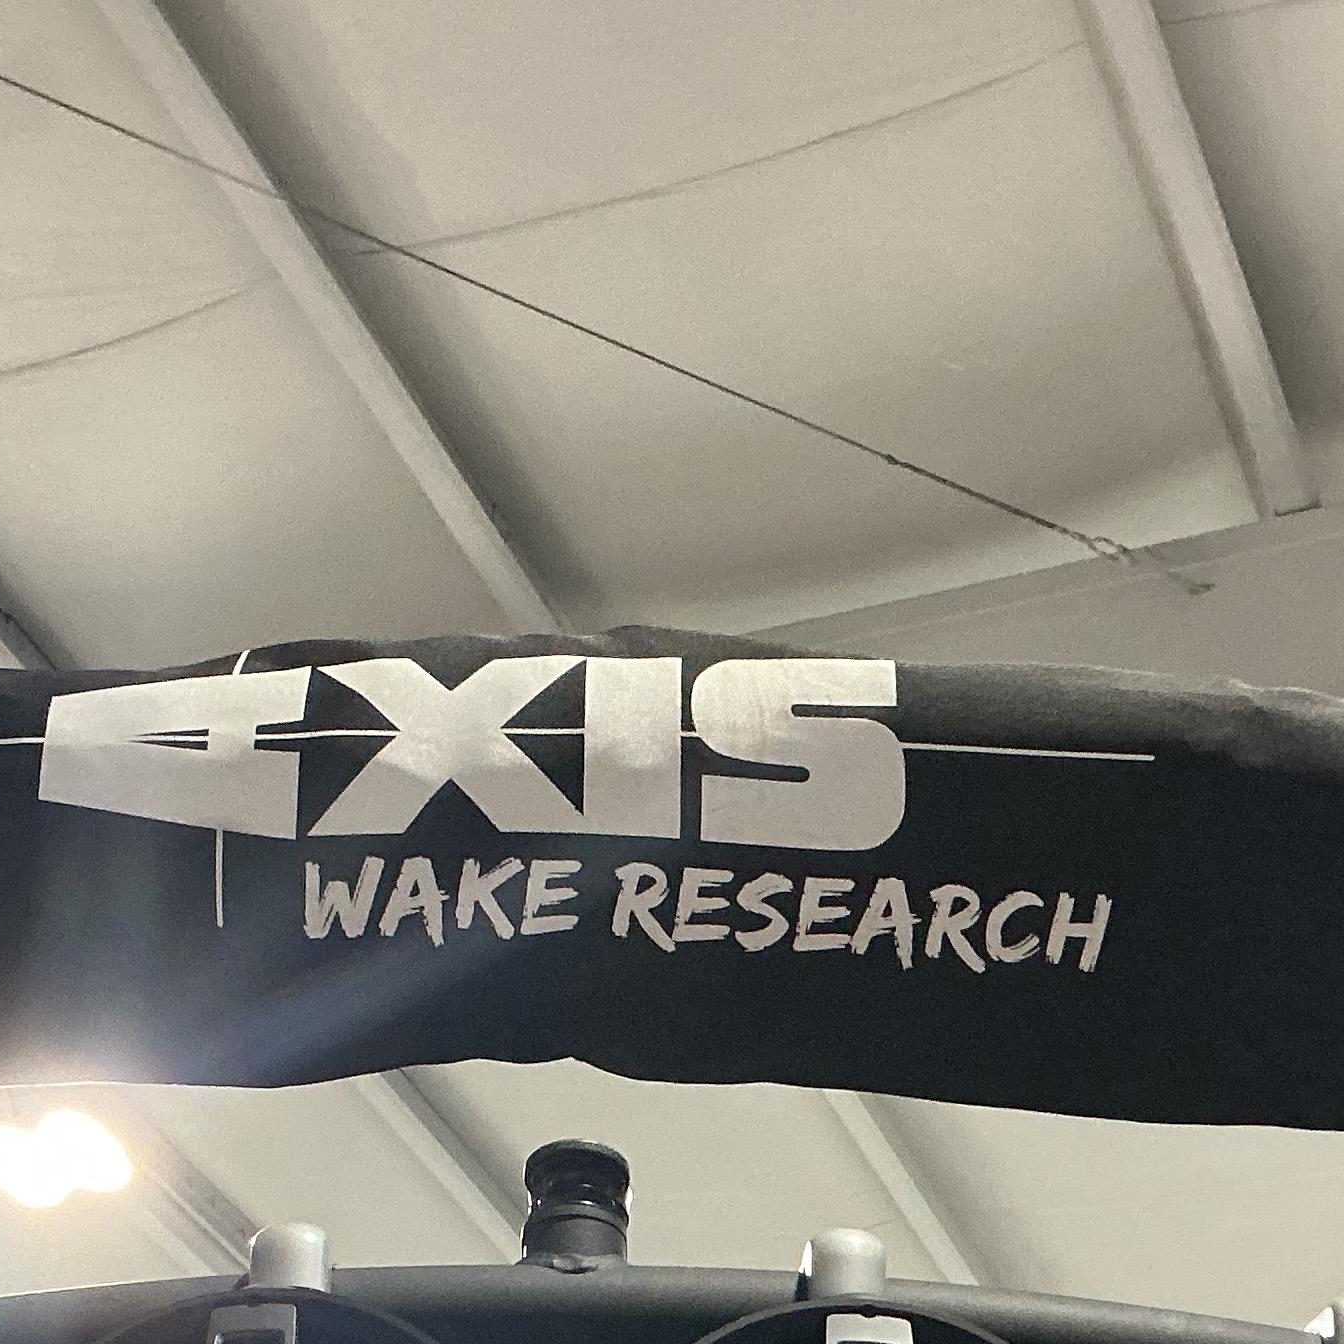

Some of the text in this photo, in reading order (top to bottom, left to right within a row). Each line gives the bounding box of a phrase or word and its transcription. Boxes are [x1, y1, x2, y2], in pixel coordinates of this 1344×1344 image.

[39, 655, 907, 851] AXIS
[303, 855, 1113, 974] WAKE RESEARCH
